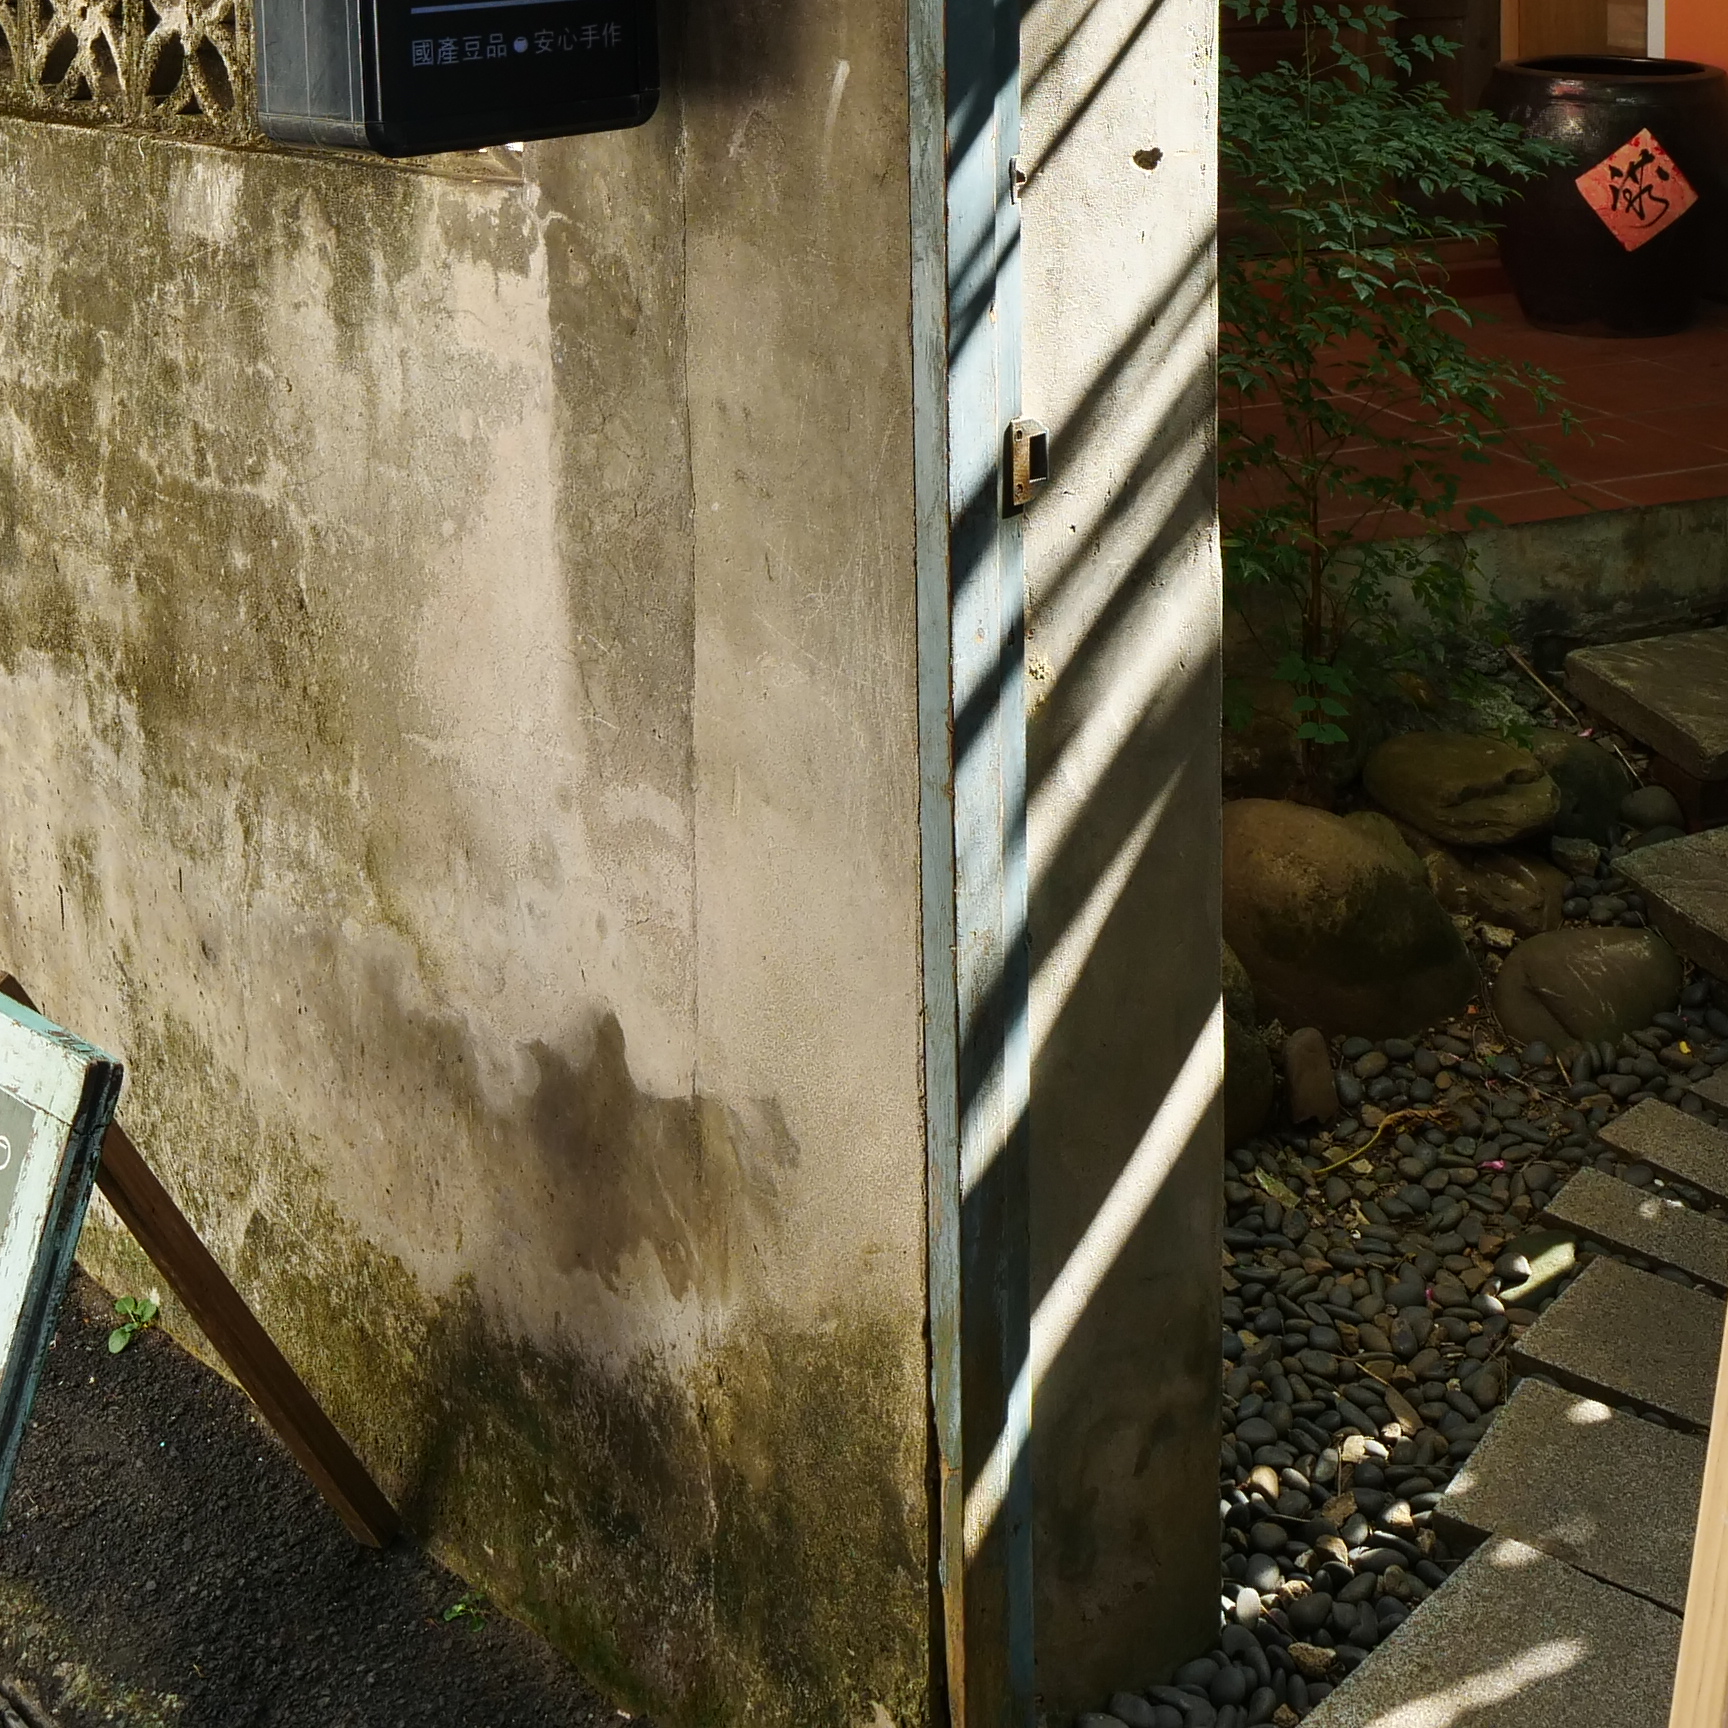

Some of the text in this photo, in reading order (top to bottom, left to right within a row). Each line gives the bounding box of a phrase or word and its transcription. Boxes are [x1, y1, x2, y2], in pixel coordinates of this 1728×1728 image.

[412, 21, 622, 68] 國產豆品 安心手作
